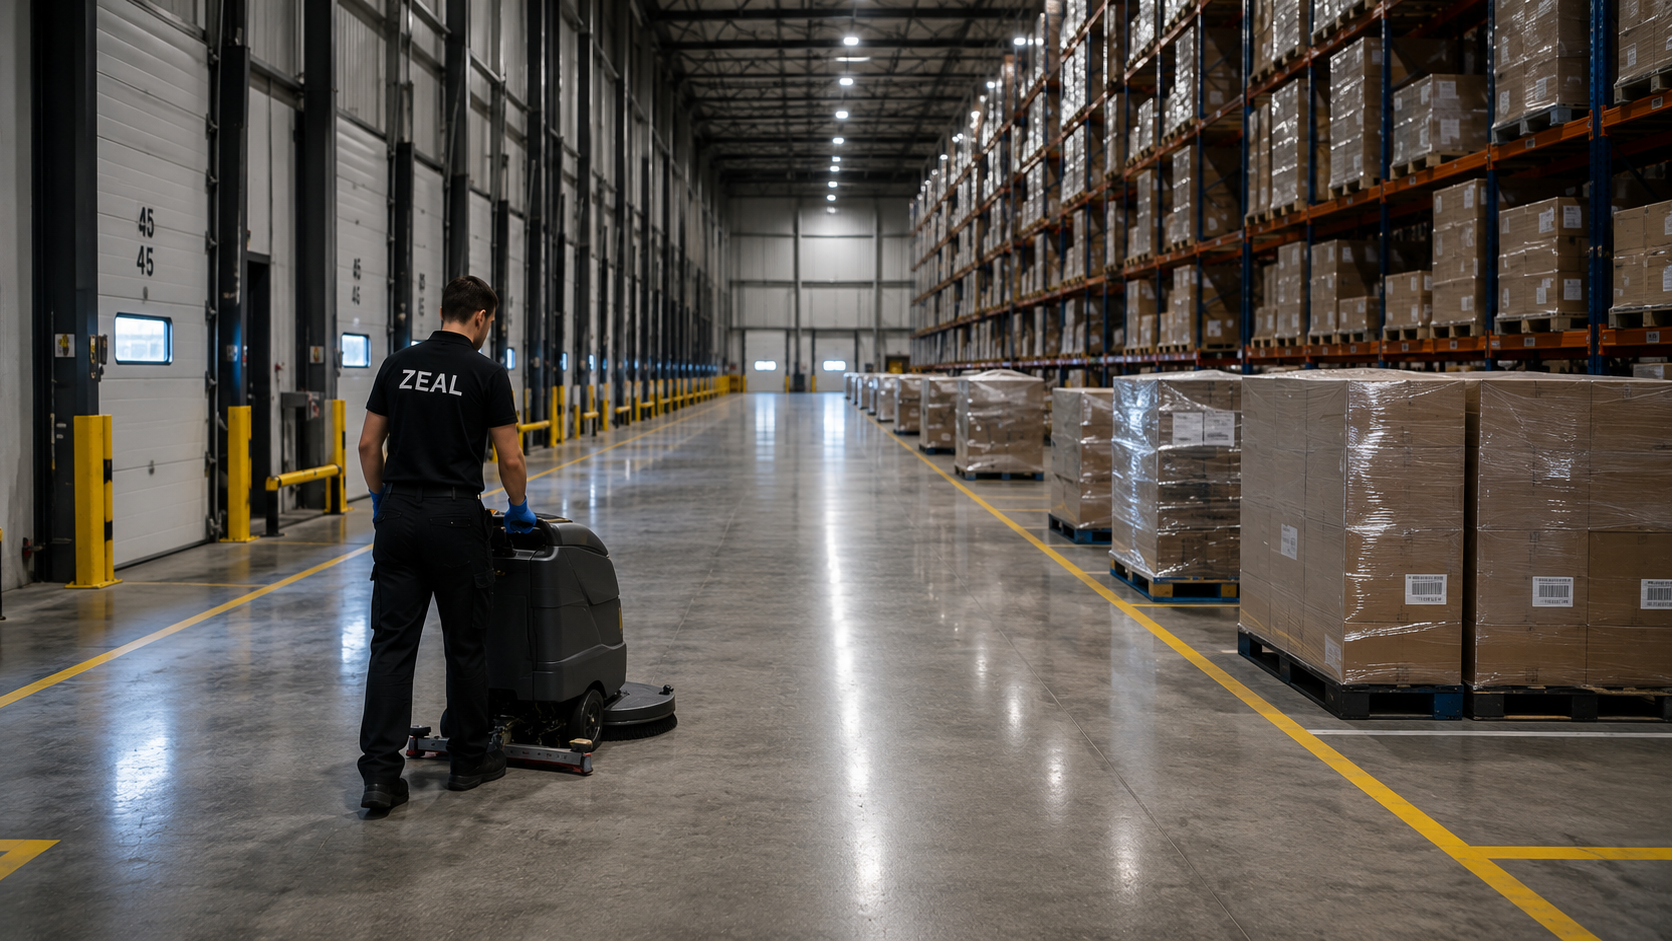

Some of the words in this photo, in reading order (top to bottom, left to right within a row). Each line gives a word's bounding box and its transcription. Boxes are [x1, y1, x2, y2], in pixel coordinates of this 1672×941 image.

[138, 206, 155, 239] 45
[136, 245, 154, 277] 45
[398, 369, 463, 397] ZEAL
